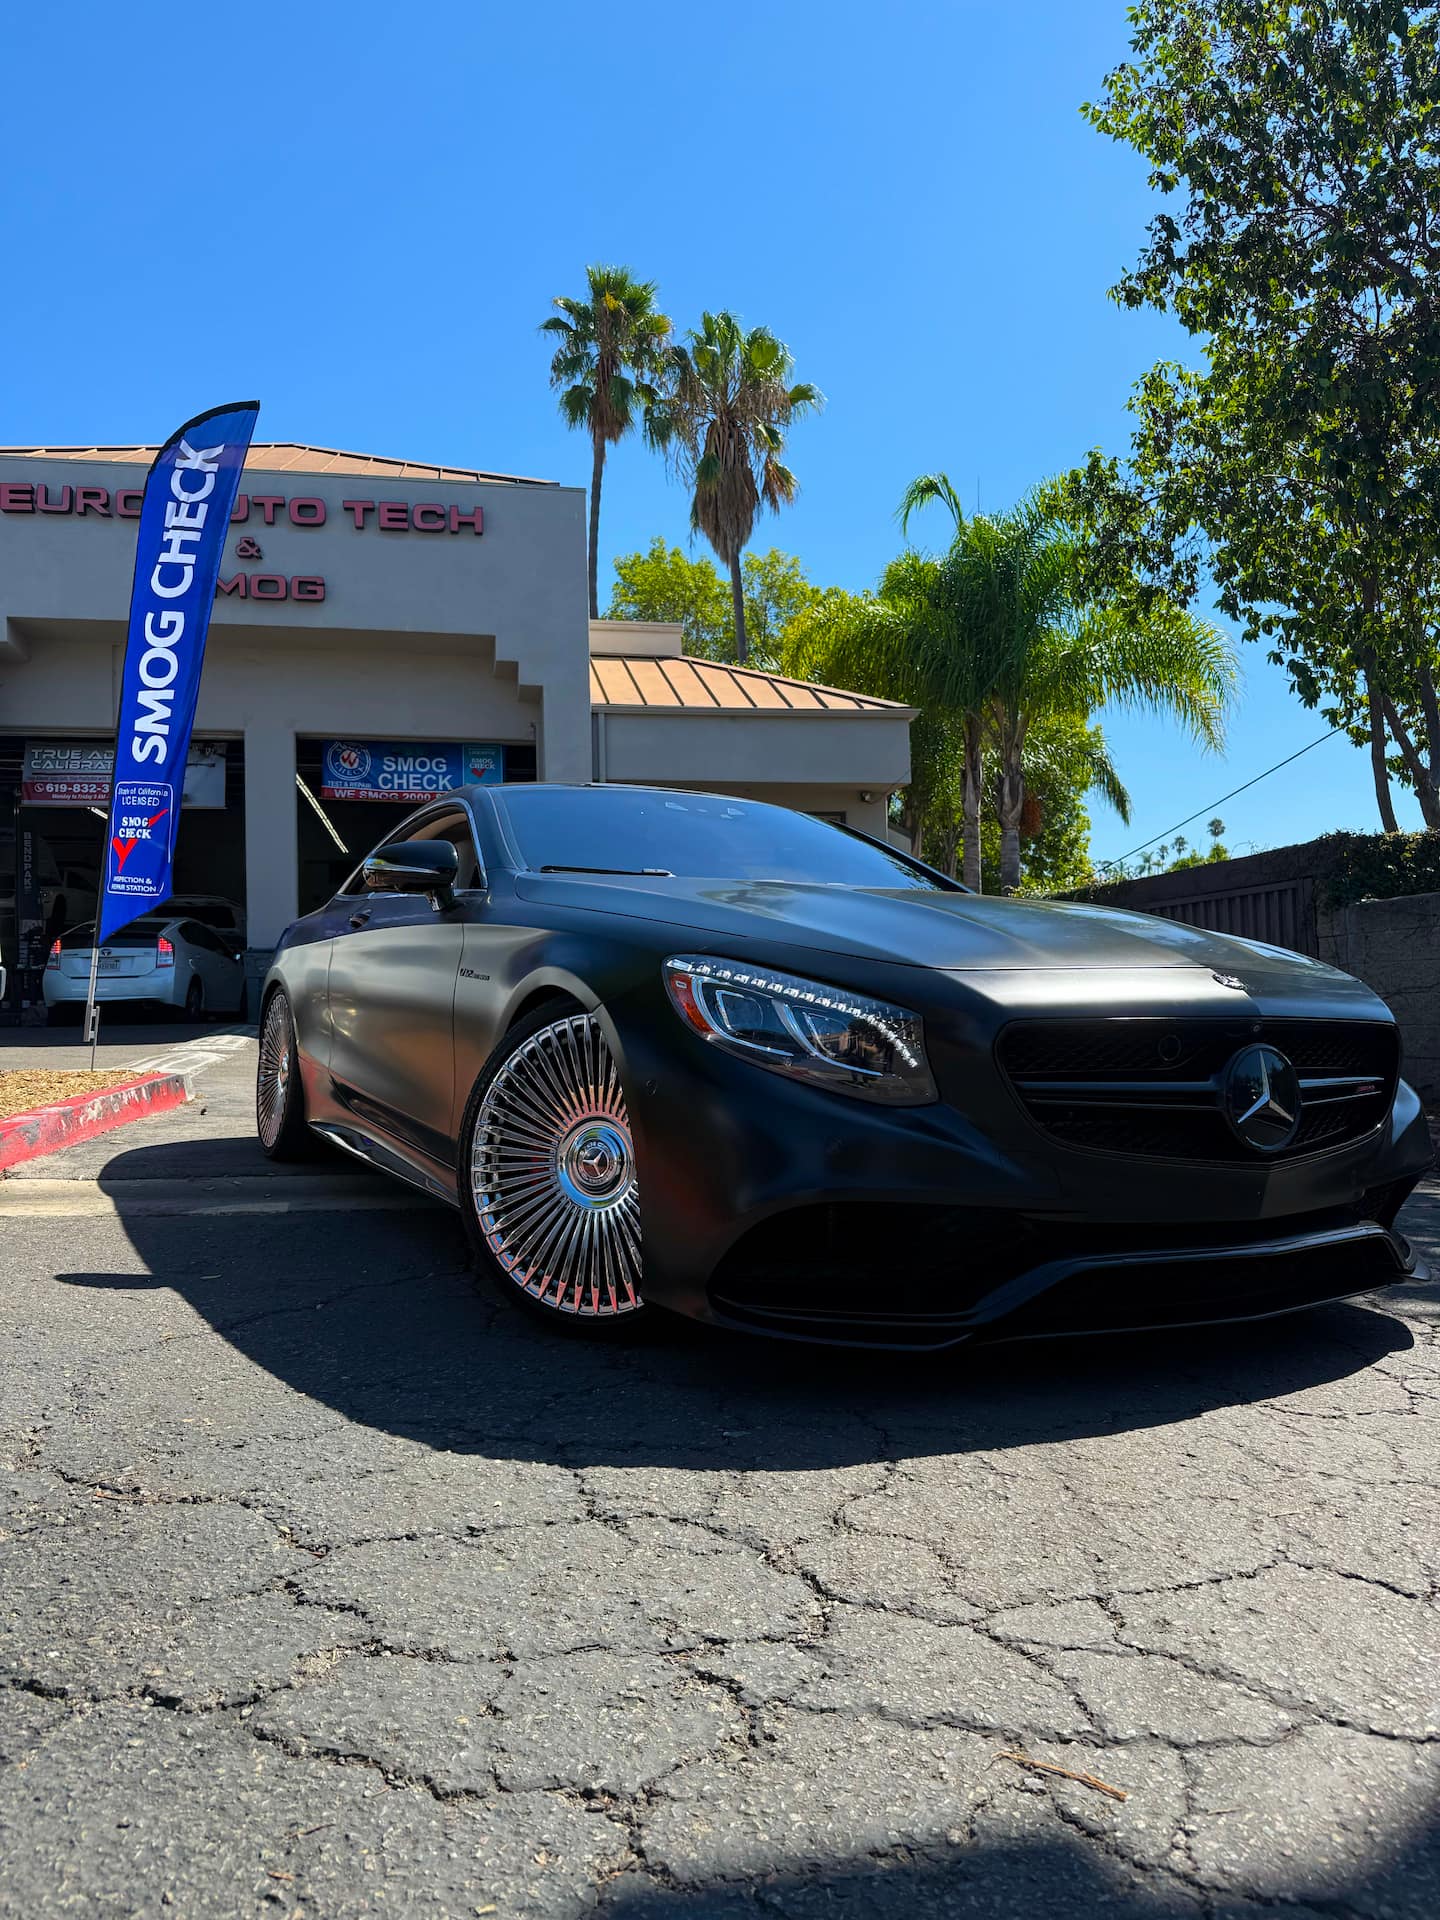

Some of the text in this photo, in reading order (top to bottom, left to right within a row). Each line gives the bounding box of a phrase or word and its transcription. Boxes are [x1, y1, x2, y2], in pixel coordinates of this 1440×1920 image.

[343, 499, 485, 536] TECH
[235, 536, 263, 560] &
[215, 572, 326, 602] MOG
[132, 439, 225, 765] SMOG CHECK
[31, 749, 115, 760] TRUE AD
[31, 760, 113, 770] CALIBRAT
[383, 757, 448, 773] SMOG
[46, 783, 110, 793] 619-832-3
[378, 773, 453, 791] CHECK
[334, 789, 356, 799] WE
[360, 790, 400, 800] SMOG
[402, 792, 431, 801] 2000
[121, 816, 149, 827] SMOG
[118, 828, 152, 839] CHECK
[126, 884, 157, 892] STATION
